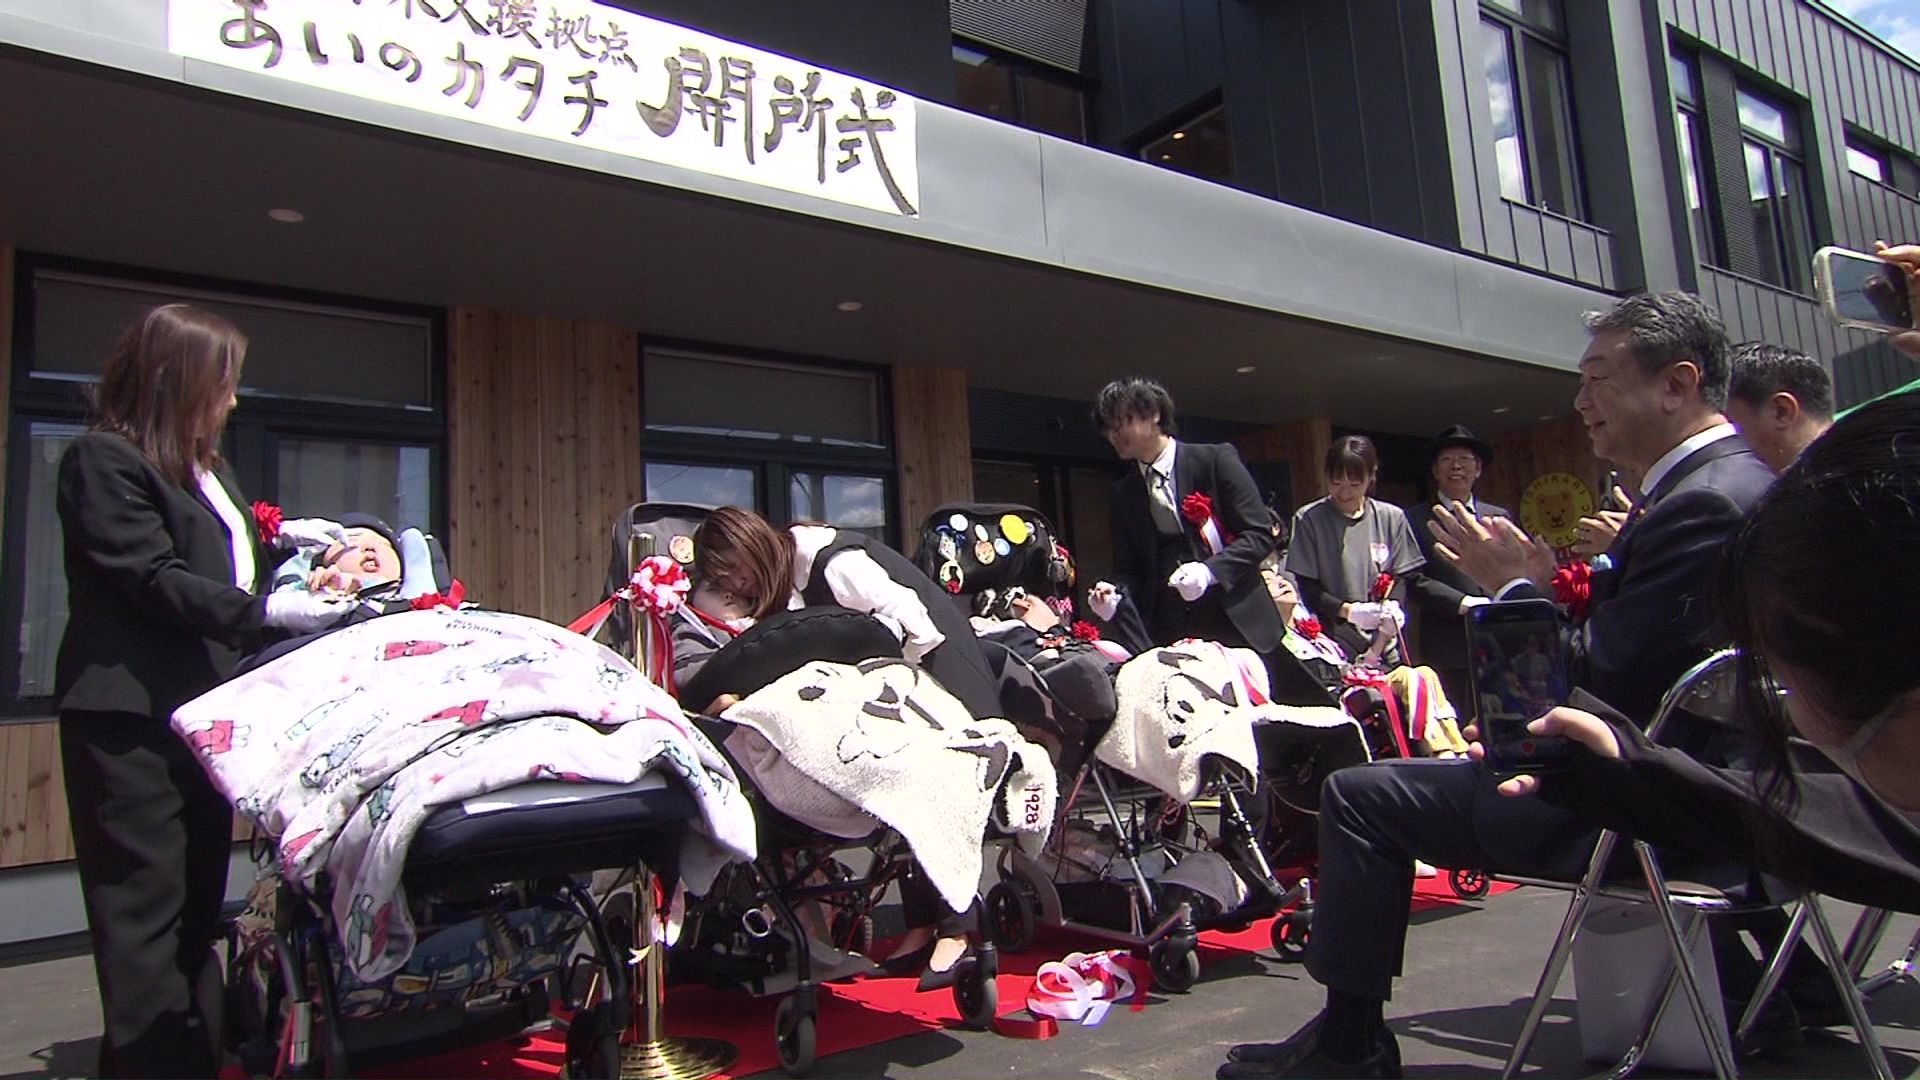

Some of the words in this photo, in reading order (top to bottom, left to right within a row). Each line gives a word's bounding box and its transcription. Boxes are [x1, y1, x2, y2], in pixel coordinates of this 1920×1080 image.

[219, 0, 609, 137] あいのカタチ
[635, 46, 918, 216] 開所式
[1024, 787, 1041, 824] 1928
